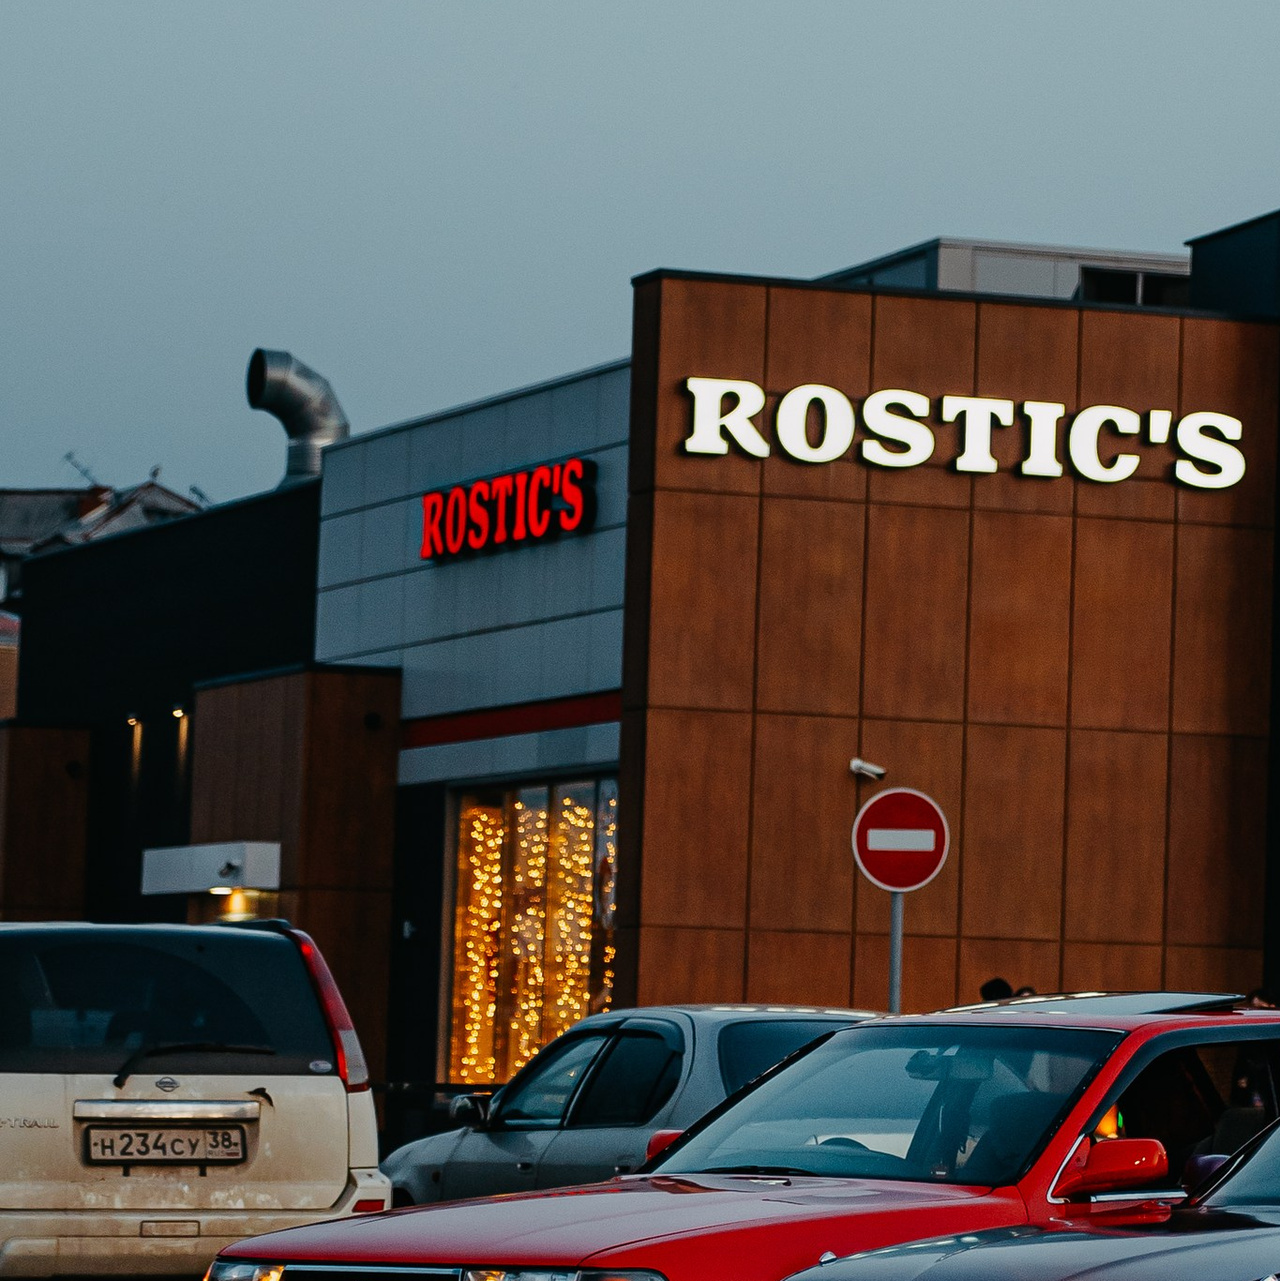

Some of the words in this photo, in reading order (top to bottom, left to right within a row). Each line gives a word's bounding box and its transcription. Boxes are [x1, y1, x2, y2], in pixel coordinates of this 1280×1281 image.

[684, 377, 1246, 489] ROSTIC'S
[420, 458, 584, 559] ROSTIC'S
[0, 1117, 60, 1129] -TRAIL
[208, 1131, 233, 1149] 38
